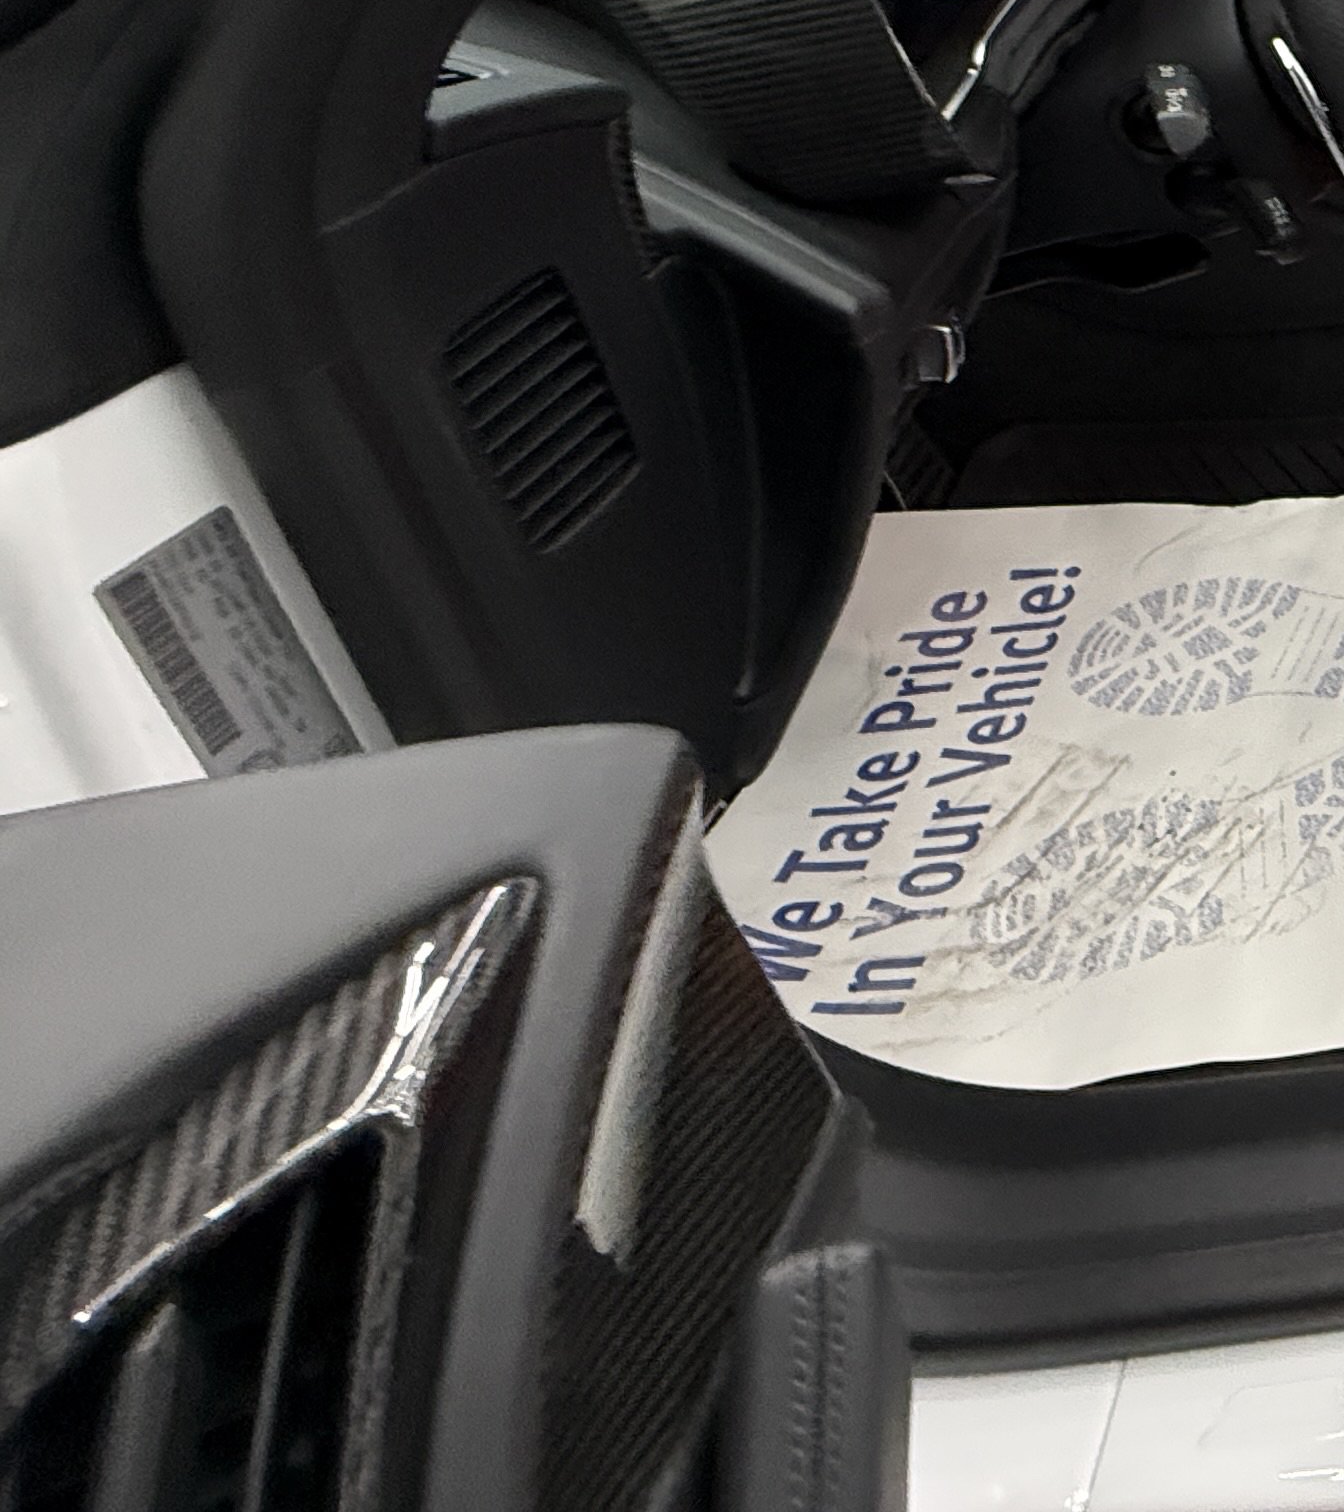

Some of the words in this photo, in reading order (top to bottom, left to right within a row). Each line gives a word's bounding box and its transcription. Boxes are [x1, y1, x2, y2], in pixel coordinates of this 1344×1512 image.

[857, 589, 989, 735] Pride
[925, 565, 1083, 788] Vehicle!
[773, 750, 921, 884] Take
[849, 798, 992, 940] Your
[741, 899, 844, 982] We
[810, 955, 927, 1015] In
